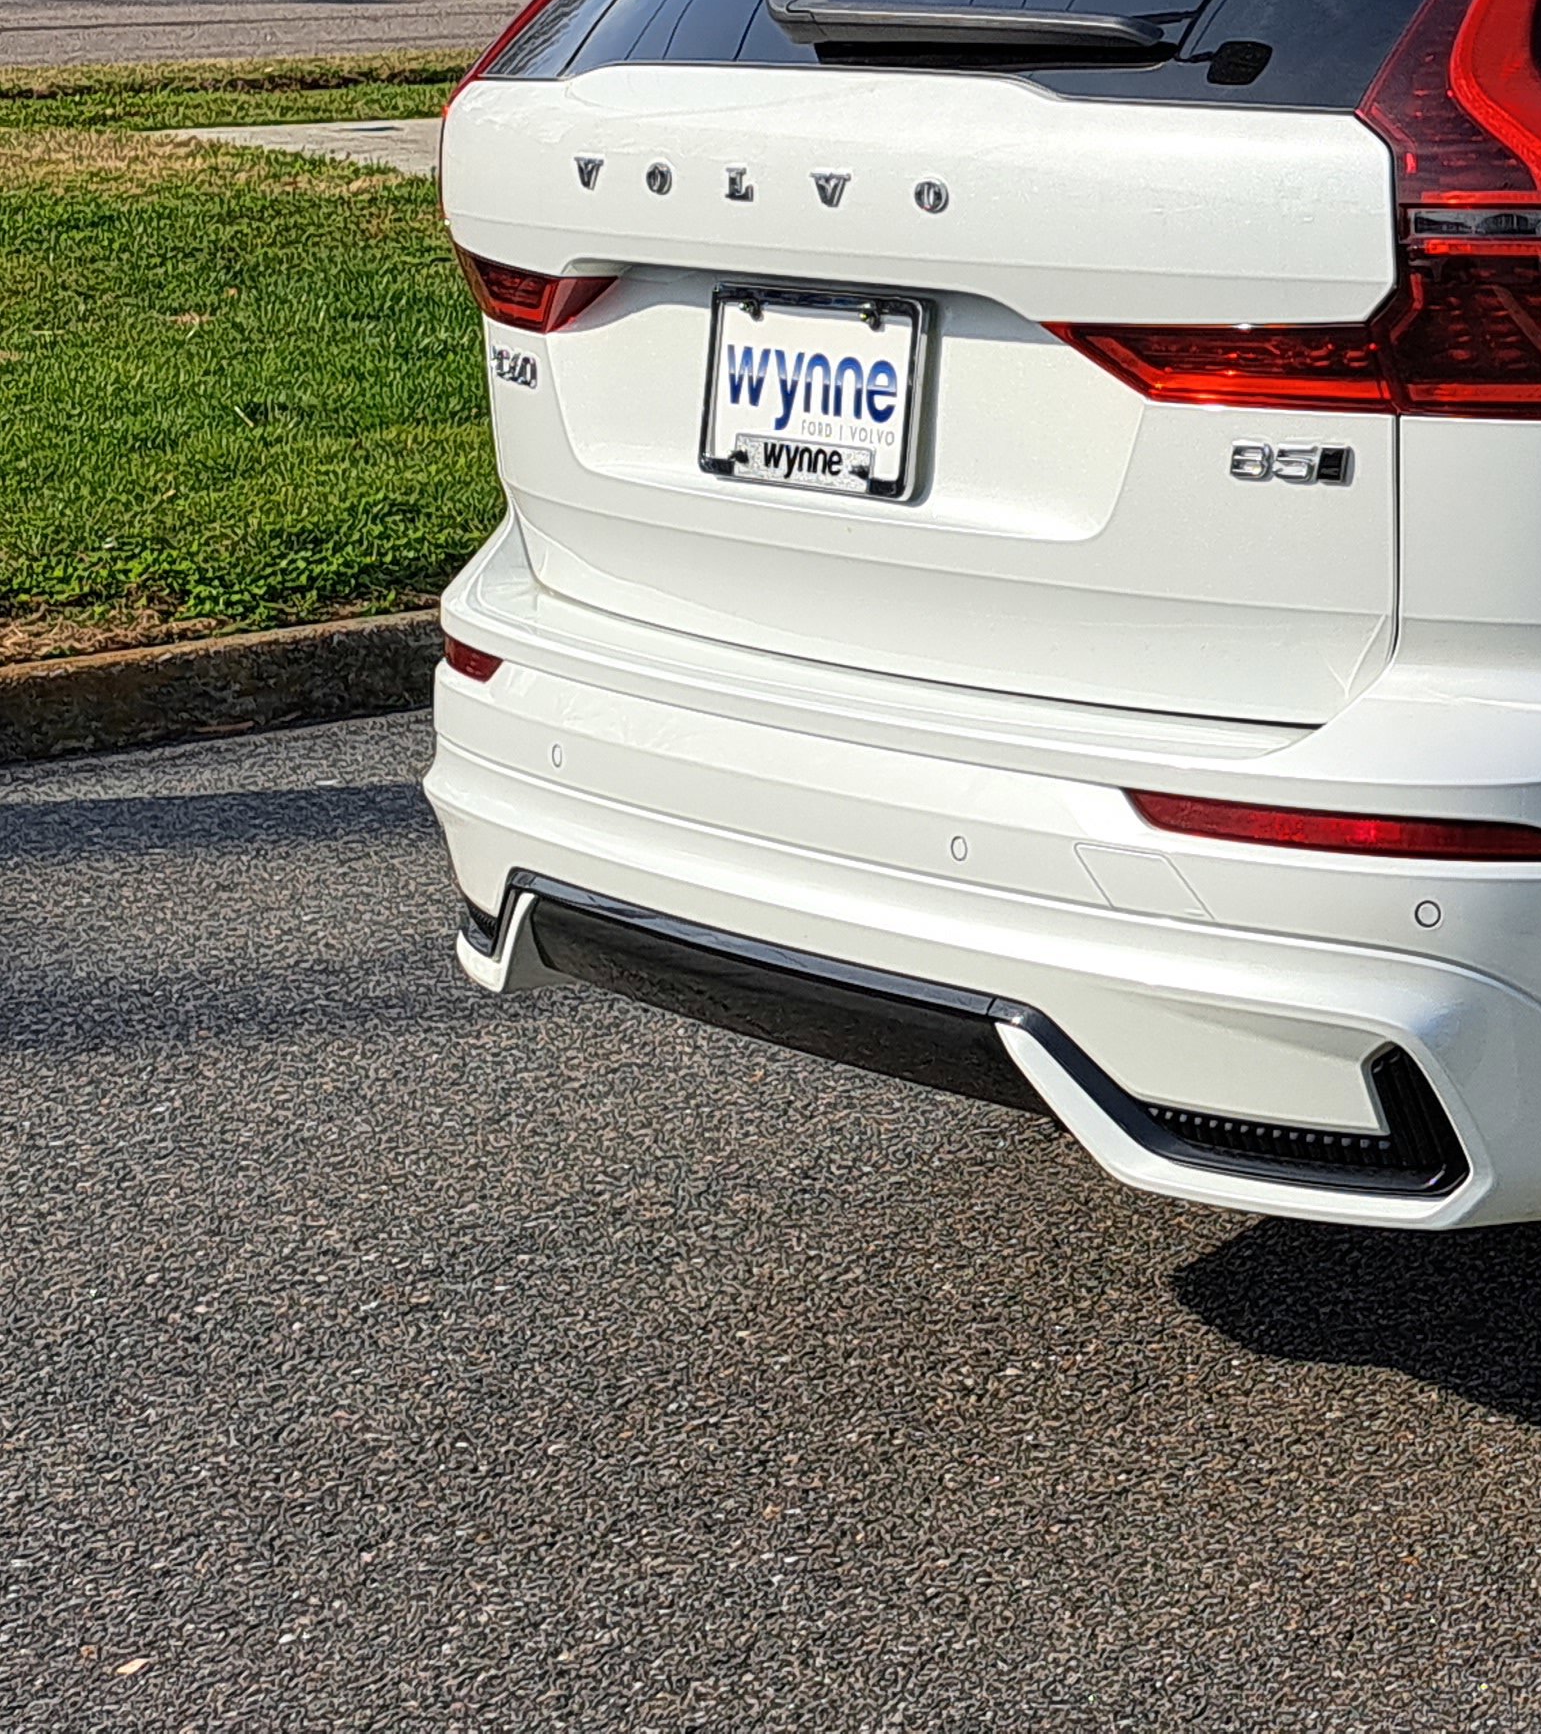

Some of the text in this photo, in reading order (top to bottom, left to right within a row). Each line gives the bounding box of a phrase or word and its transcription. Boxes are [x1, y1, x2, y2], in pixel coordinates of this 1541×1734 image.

[574, 156, 949, 214] VOLVO
[727, 344, 898, 430] wynne
[801, 419, 895, 447] FORD VOLVO
[764, 441, 842, 479] wynne
[1230, 442, 1320, 484] B5
